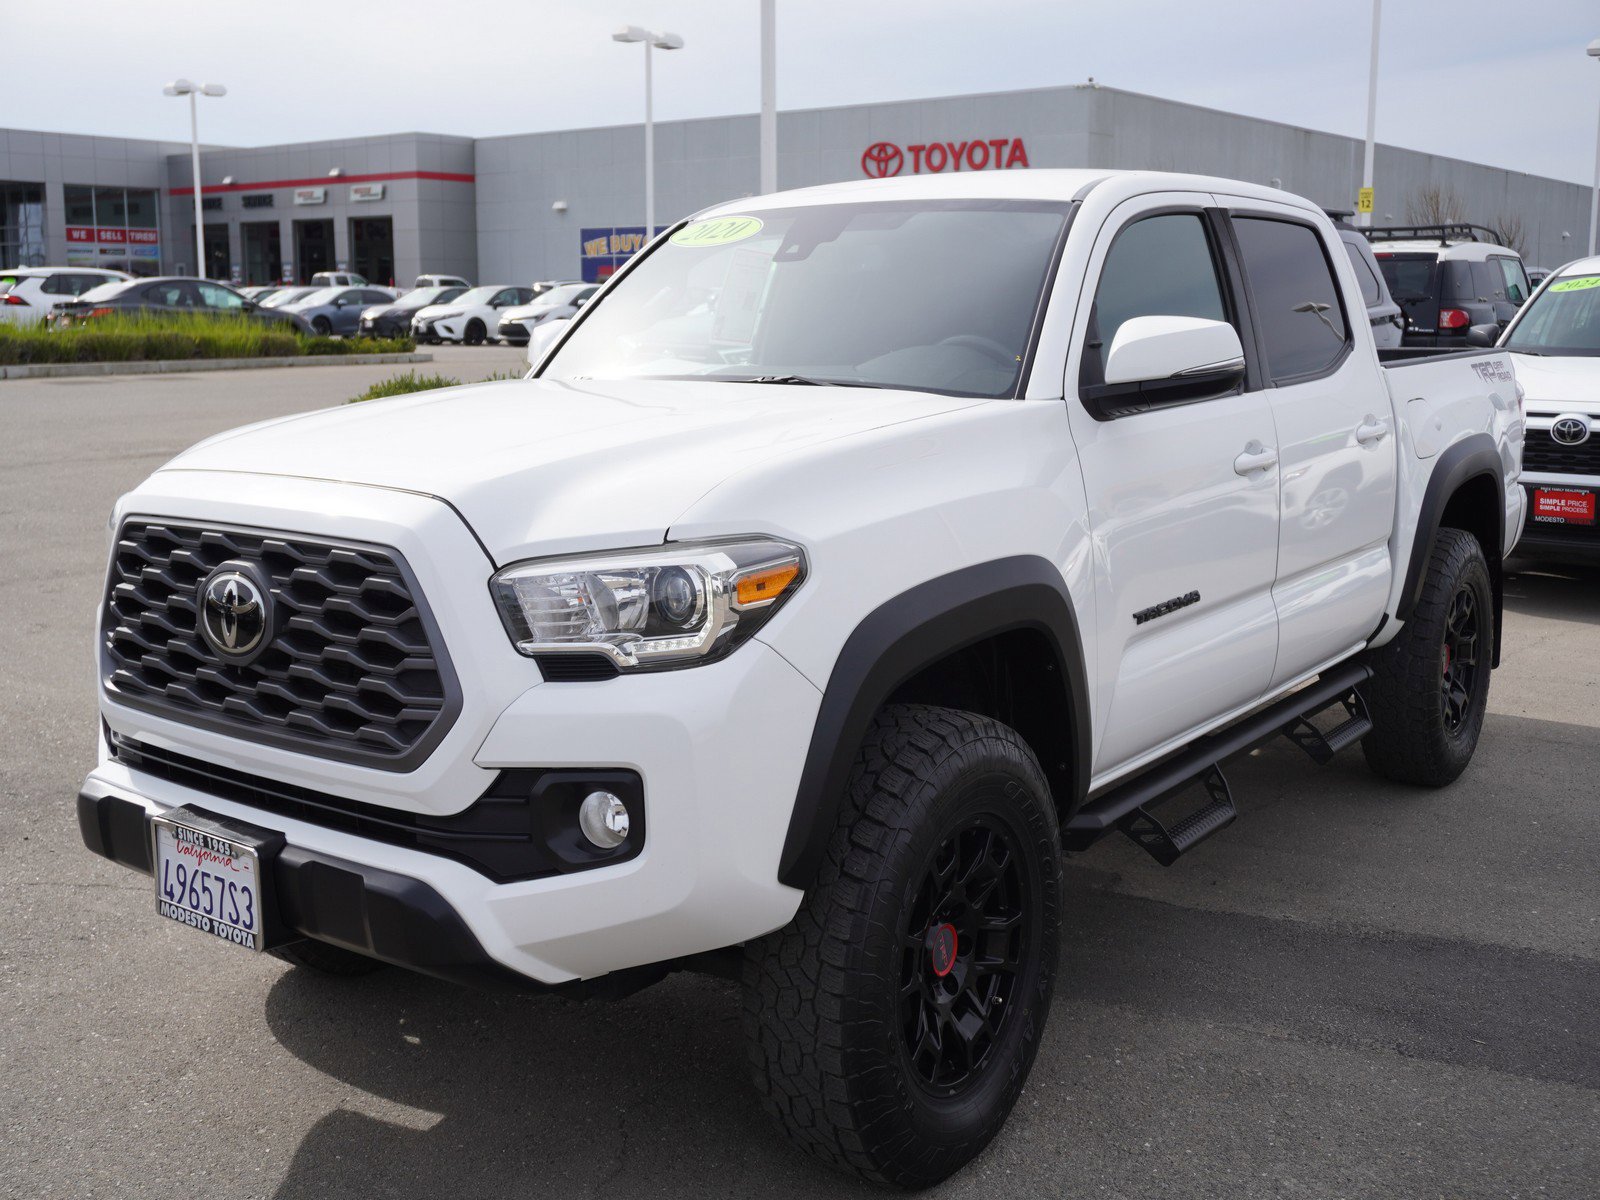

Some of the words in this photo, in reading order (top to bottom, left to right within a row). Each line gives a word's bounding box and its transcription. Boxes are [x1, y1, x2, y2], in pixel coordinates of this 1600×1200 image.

[907, 137, 1030, 174] TOYOTA
[1361, 199, 1371, 209] 12
[71, 229, 87, 240] WE
[100, 230, 123, 241] SELL
[678, 220, 753, 241] 2020
[583, 236, 608, 259] WE
[609, 233, 644, 254] BUY
[1471, 361, 1496, 384] TRD
[1568, 500, 1589, 508] PRICE.
[1132, 590, 1201, 625] TACOMA
[177, 827, 205, 847] SINCE
[207, 837, 231, 856] 1965
[176, 839, 240, 872] California
[163, 858, 254, 931] 49657S3
[160, 900, 211, 932] MODESTO
[212, 918, 256, 949] TOYOTA
